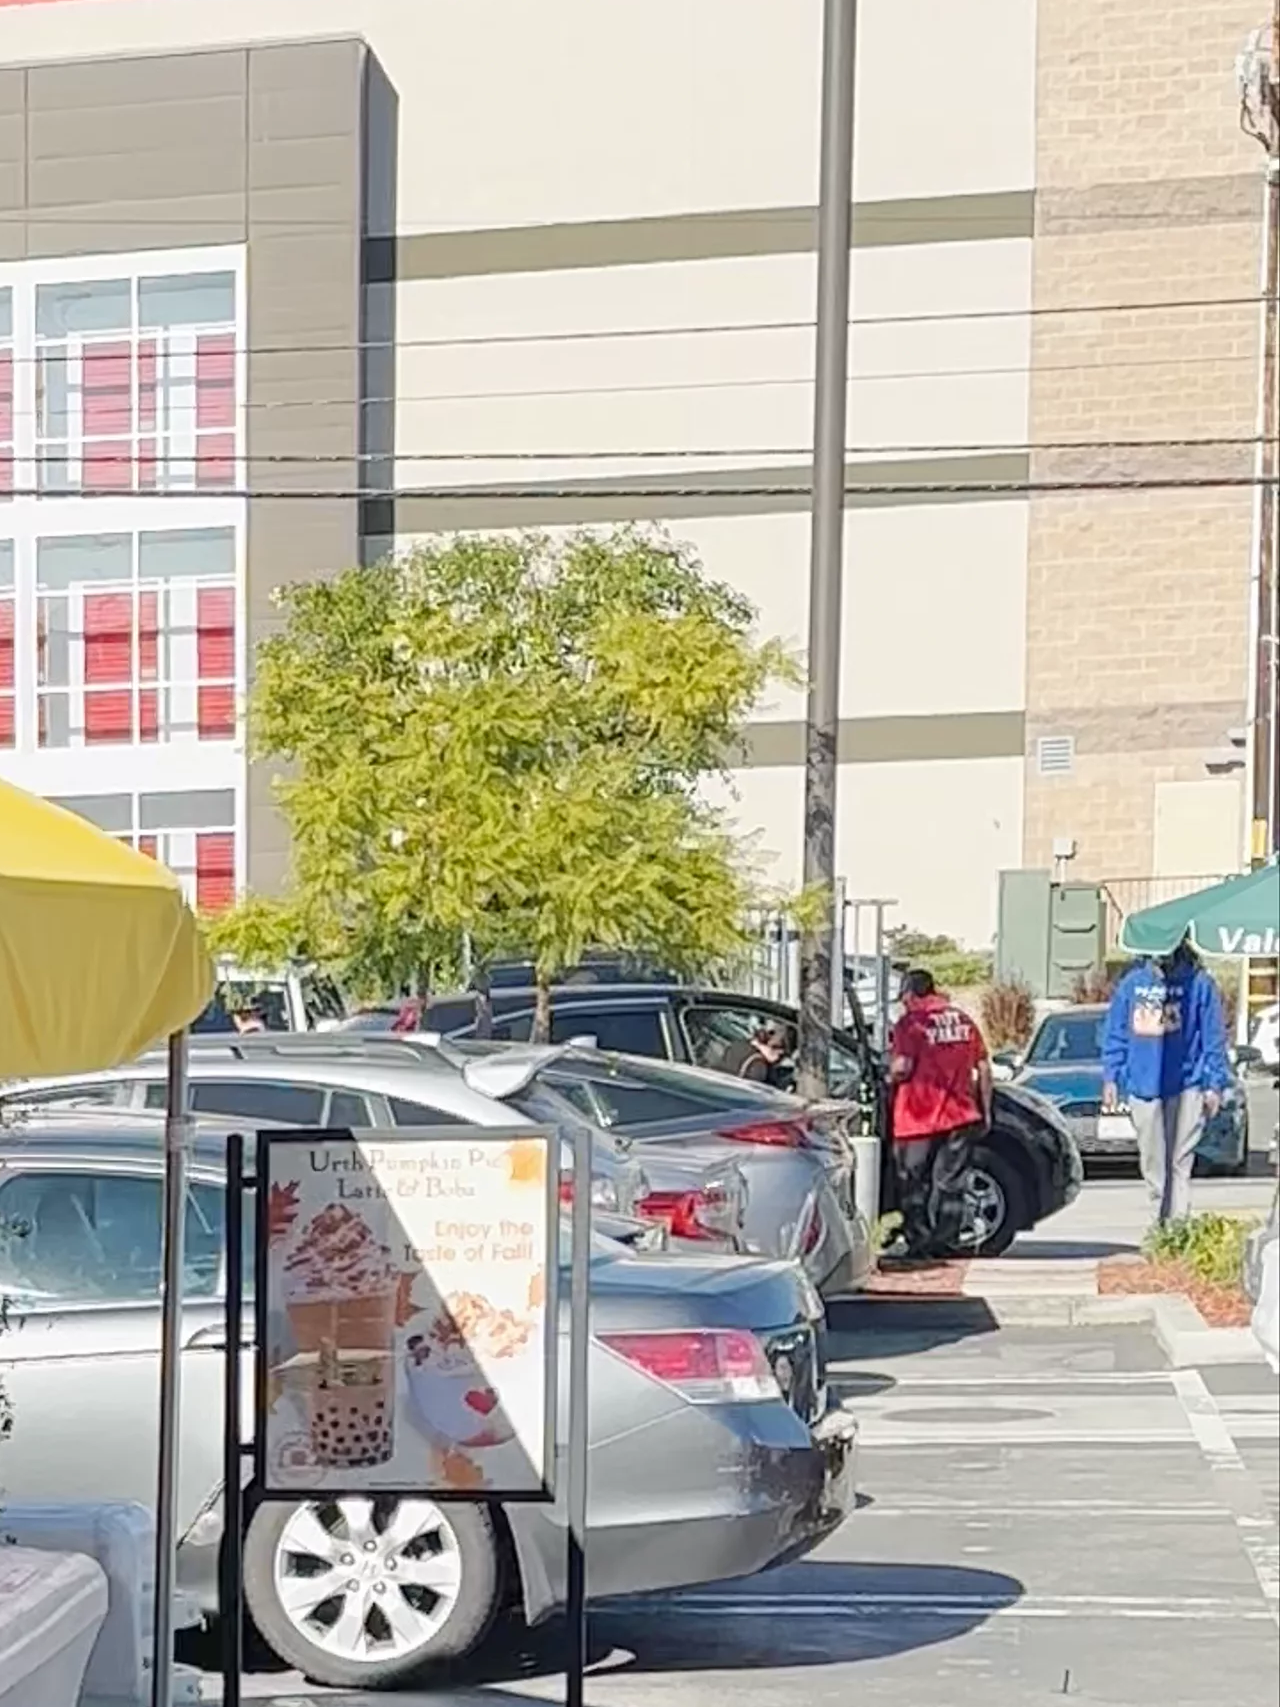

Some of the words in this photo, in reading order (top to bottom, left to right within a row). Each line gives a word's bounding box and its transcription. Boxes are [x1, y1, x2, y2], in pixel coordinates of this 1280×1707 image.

[309, 1150, 364, 1172] Urth
[369, 1148, 463, 1173] Pumpkin
[435, 1221, 493, 1244] Enjoy
[499, 1221, 535, 1237] the
[404, 1245, 457, 1263] Taste
[464, 1245, 486, 1263] of
